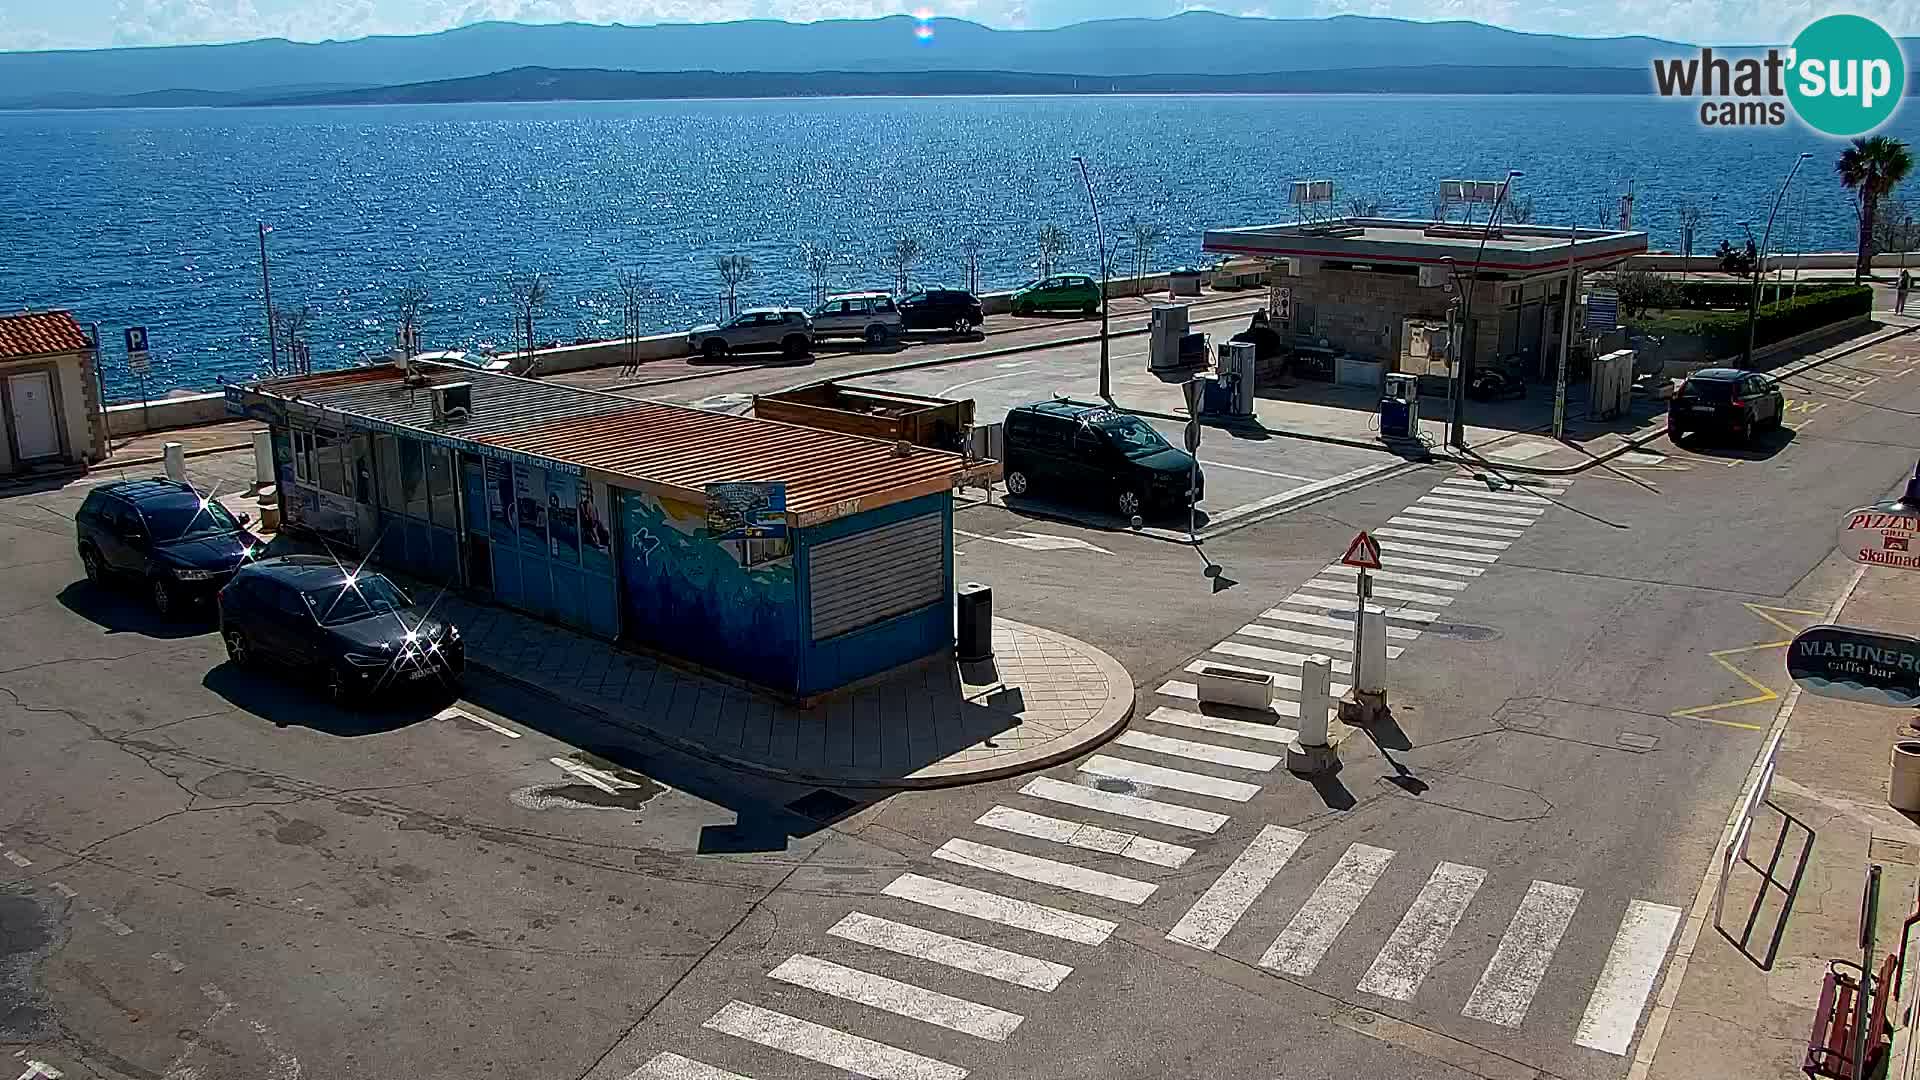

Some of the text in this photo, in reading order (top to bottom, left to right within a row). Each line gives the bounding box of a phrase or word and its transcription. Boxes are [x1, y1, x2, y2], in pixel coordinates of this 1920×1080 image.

[130, 330, 142, 349] P
[494, 448, 527, 465] STATION
[528, 455, 554, 471] TICKET
[555, 462, 582, 476] OFFICE
[1827, 660, 1897, 679] caffe bar
